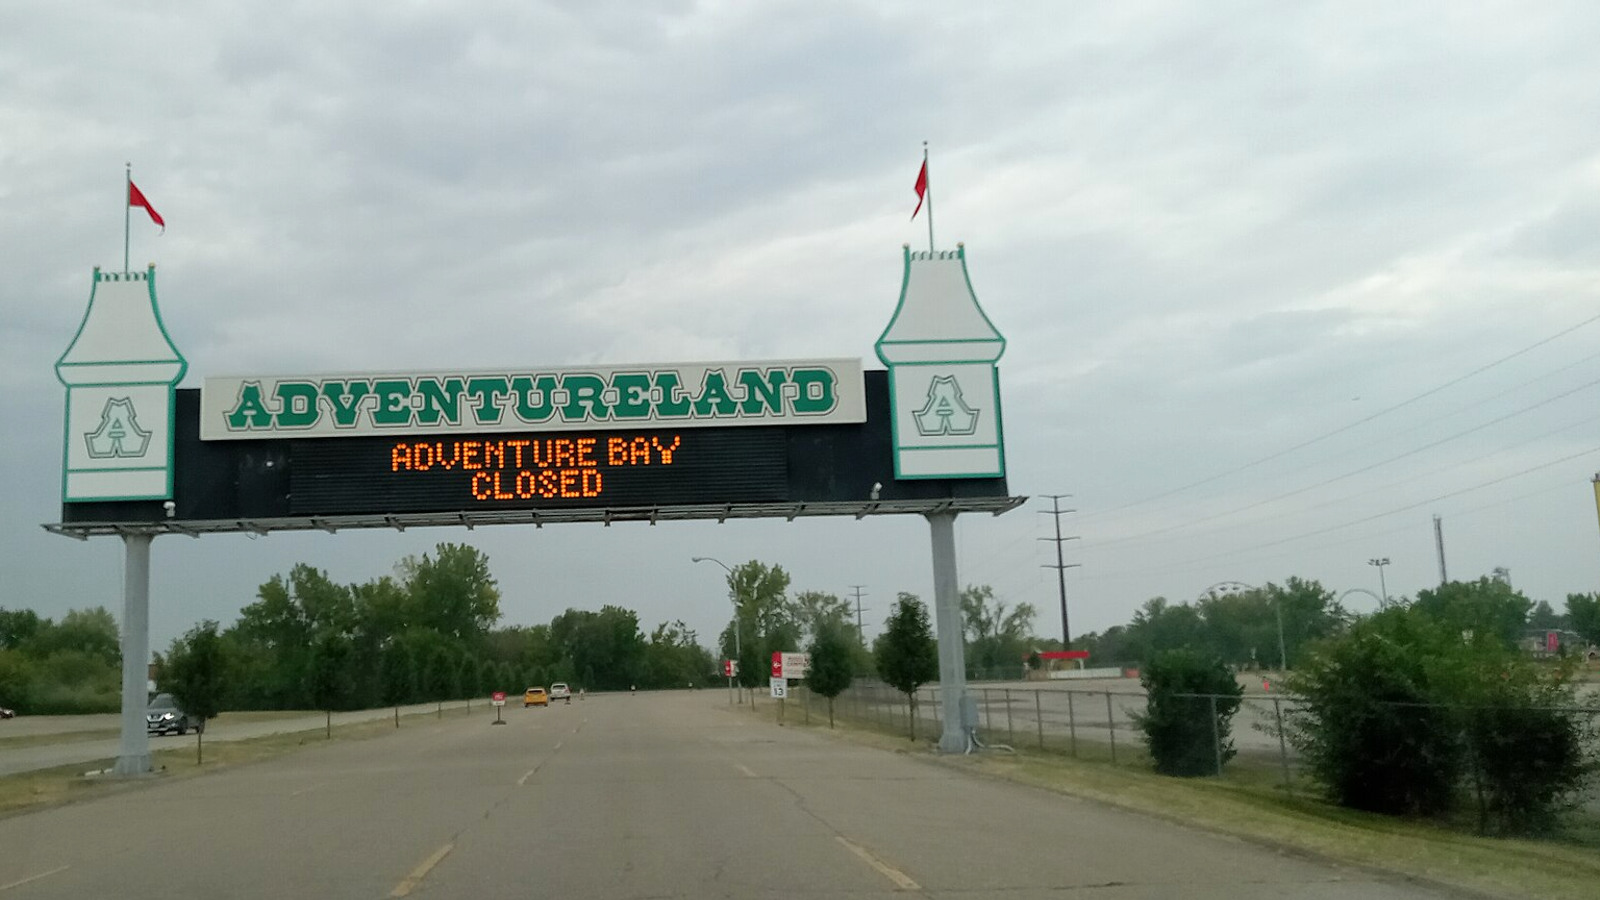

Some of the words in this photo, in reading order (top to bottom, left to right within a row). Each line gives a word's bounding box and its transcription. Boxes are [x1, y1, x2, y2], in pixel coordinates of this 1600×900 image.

[84, 396, 153, 459] A
[223, 366, 839, 431] ADVENTURELAND
[912, 374, 980, 437] A
[391, 438, 597, 471] ADVENTURE
[607, 435, 681, 465] BAY
[471, 468, 602, 500] CLOSED
